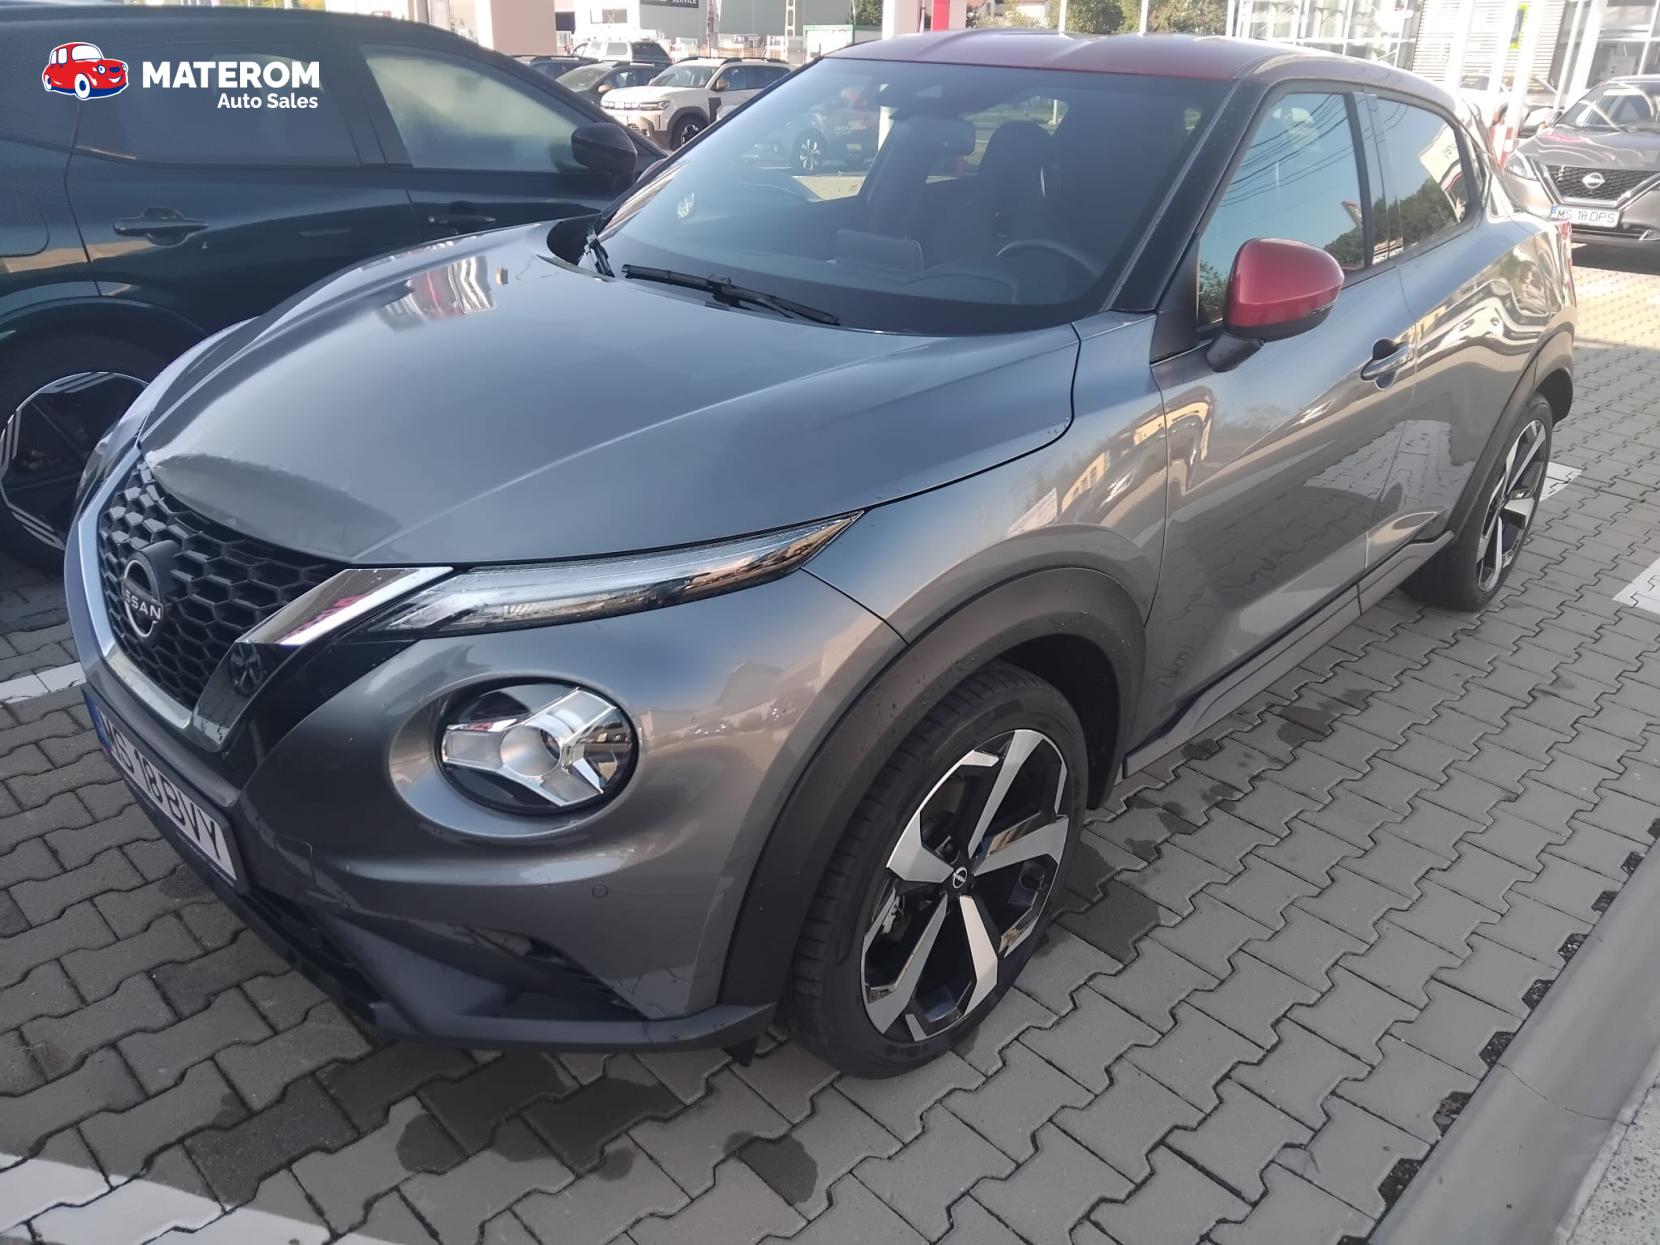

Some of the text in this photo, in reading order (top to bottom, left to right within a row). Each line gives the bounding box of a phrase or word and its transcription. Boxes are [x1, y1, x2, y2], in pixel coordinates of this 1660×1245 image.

[1578, 210, 1588, 221] 18
[1589, 211, 1615, 223] DPS
[134, 749, 163, 803] 18
[159, 773, 222, 860] BVY
